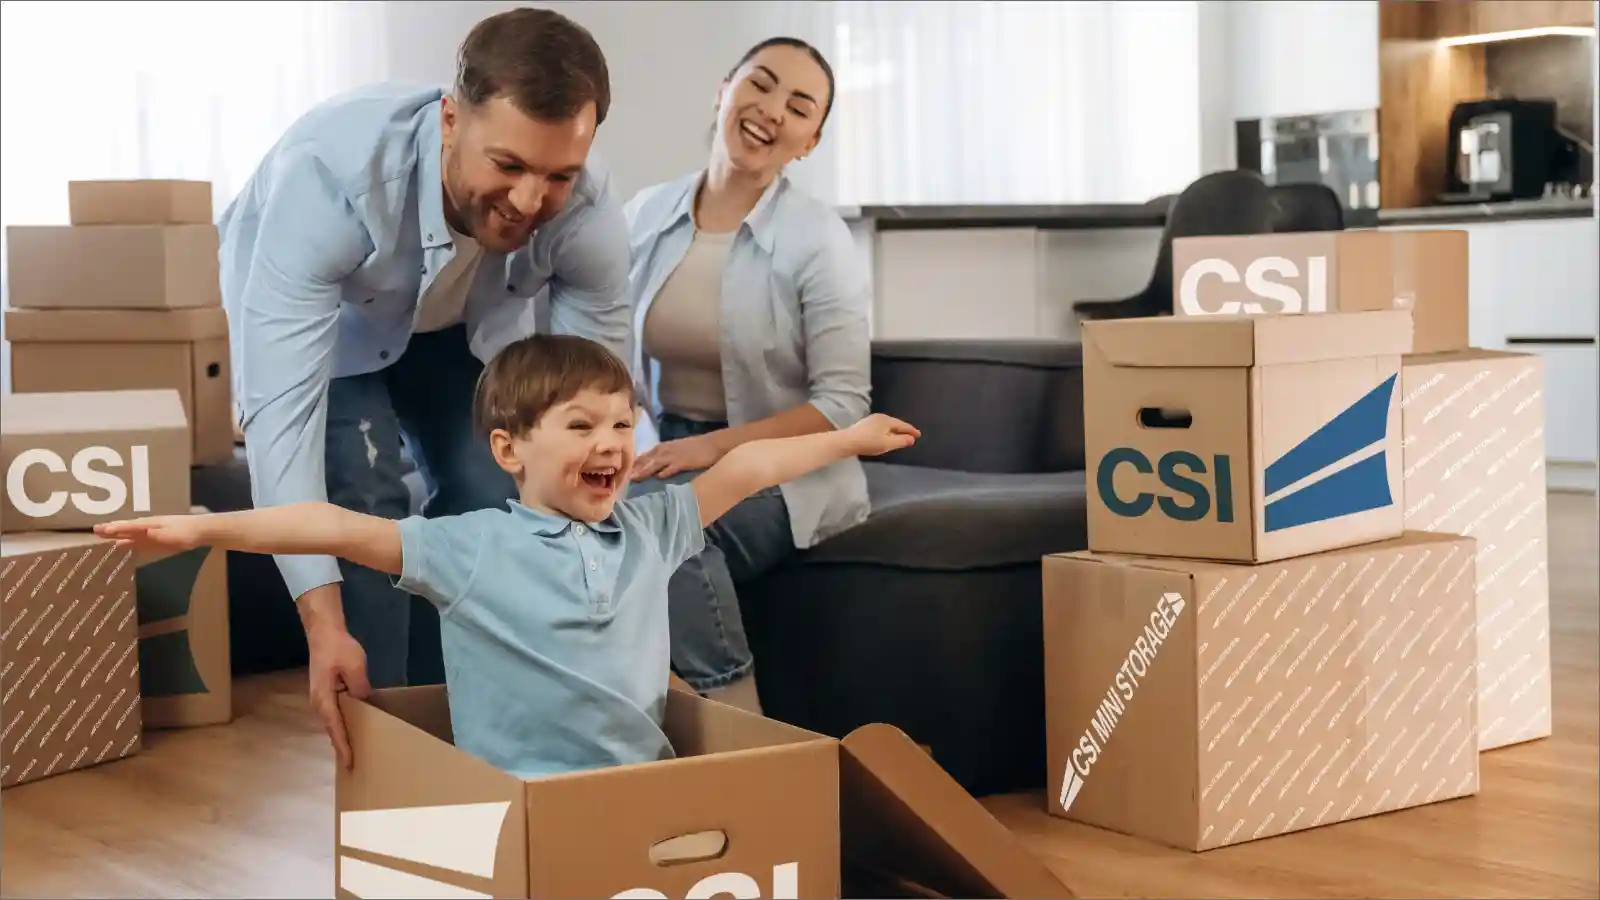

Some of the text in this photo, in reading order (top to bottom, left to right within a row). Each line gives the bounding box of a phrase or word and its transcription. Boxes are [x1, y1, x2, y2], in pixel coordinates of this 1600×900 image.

[1179, 256, 1327, 315] CSI
[6, 445, 151, 518] CSI
[1096, 447, 1234, 523] CSI
[1072, 596, 1177, 776] CSI MINI STORAGE
